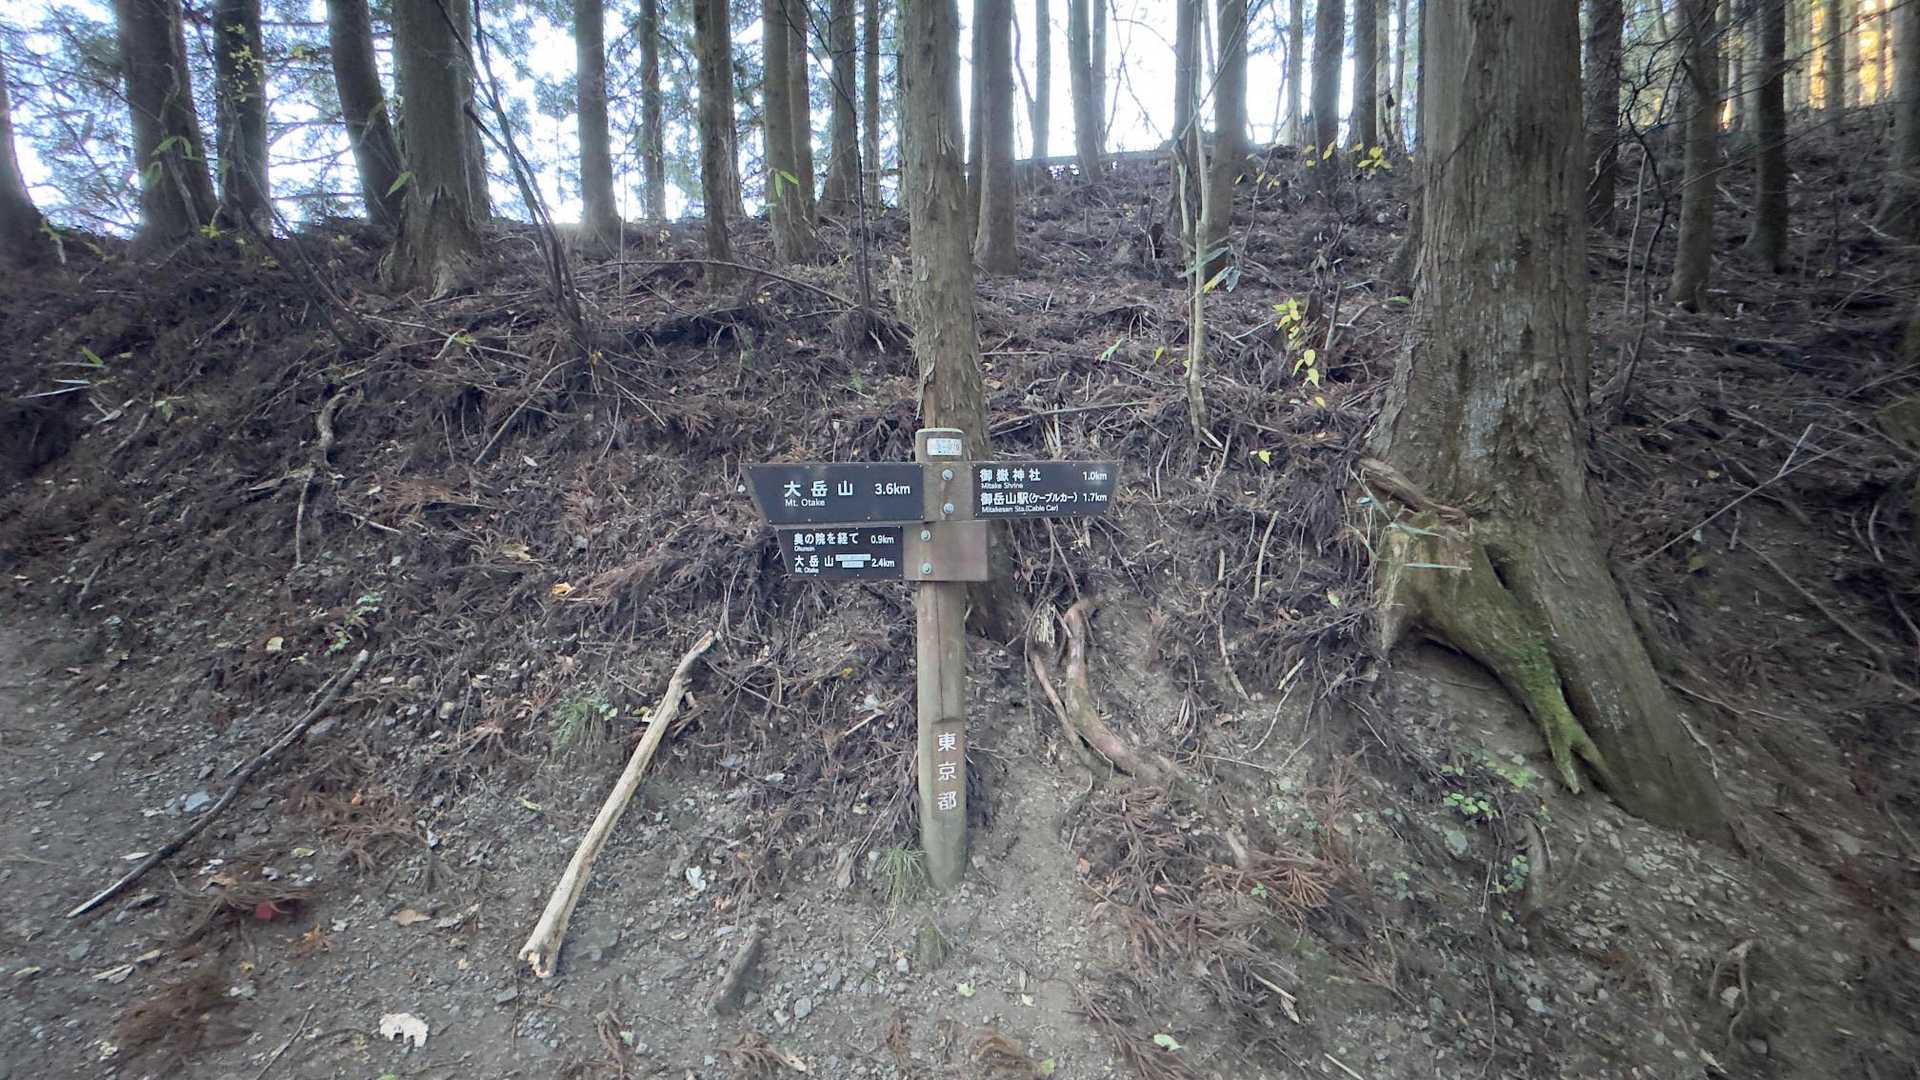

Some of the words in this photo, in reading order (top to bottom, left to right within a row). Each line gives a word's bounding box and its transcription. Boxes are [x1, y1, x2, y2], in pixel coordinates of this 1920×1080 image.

[979, 468, 1041, 482] 御嶽神社
[1082, 471, 1107, 481] 1.0km
[784, 480, 854, 498] 大岳山
[874, 483, 911, 495] 3.6km
[785, 499, 798, 507] Mt.
[801, 499, 826, 507] Otake
[1083, 493, 1107, 502] 1.7km
[794, 532, 859, 545] 奥の院を経て
[870, 534, 895, 544] 0.9km
[794, 554, 834, 567] 大岳山
[871, 558, 895, 568] 2.4km
[937, 732, 957, 811] 東京都
